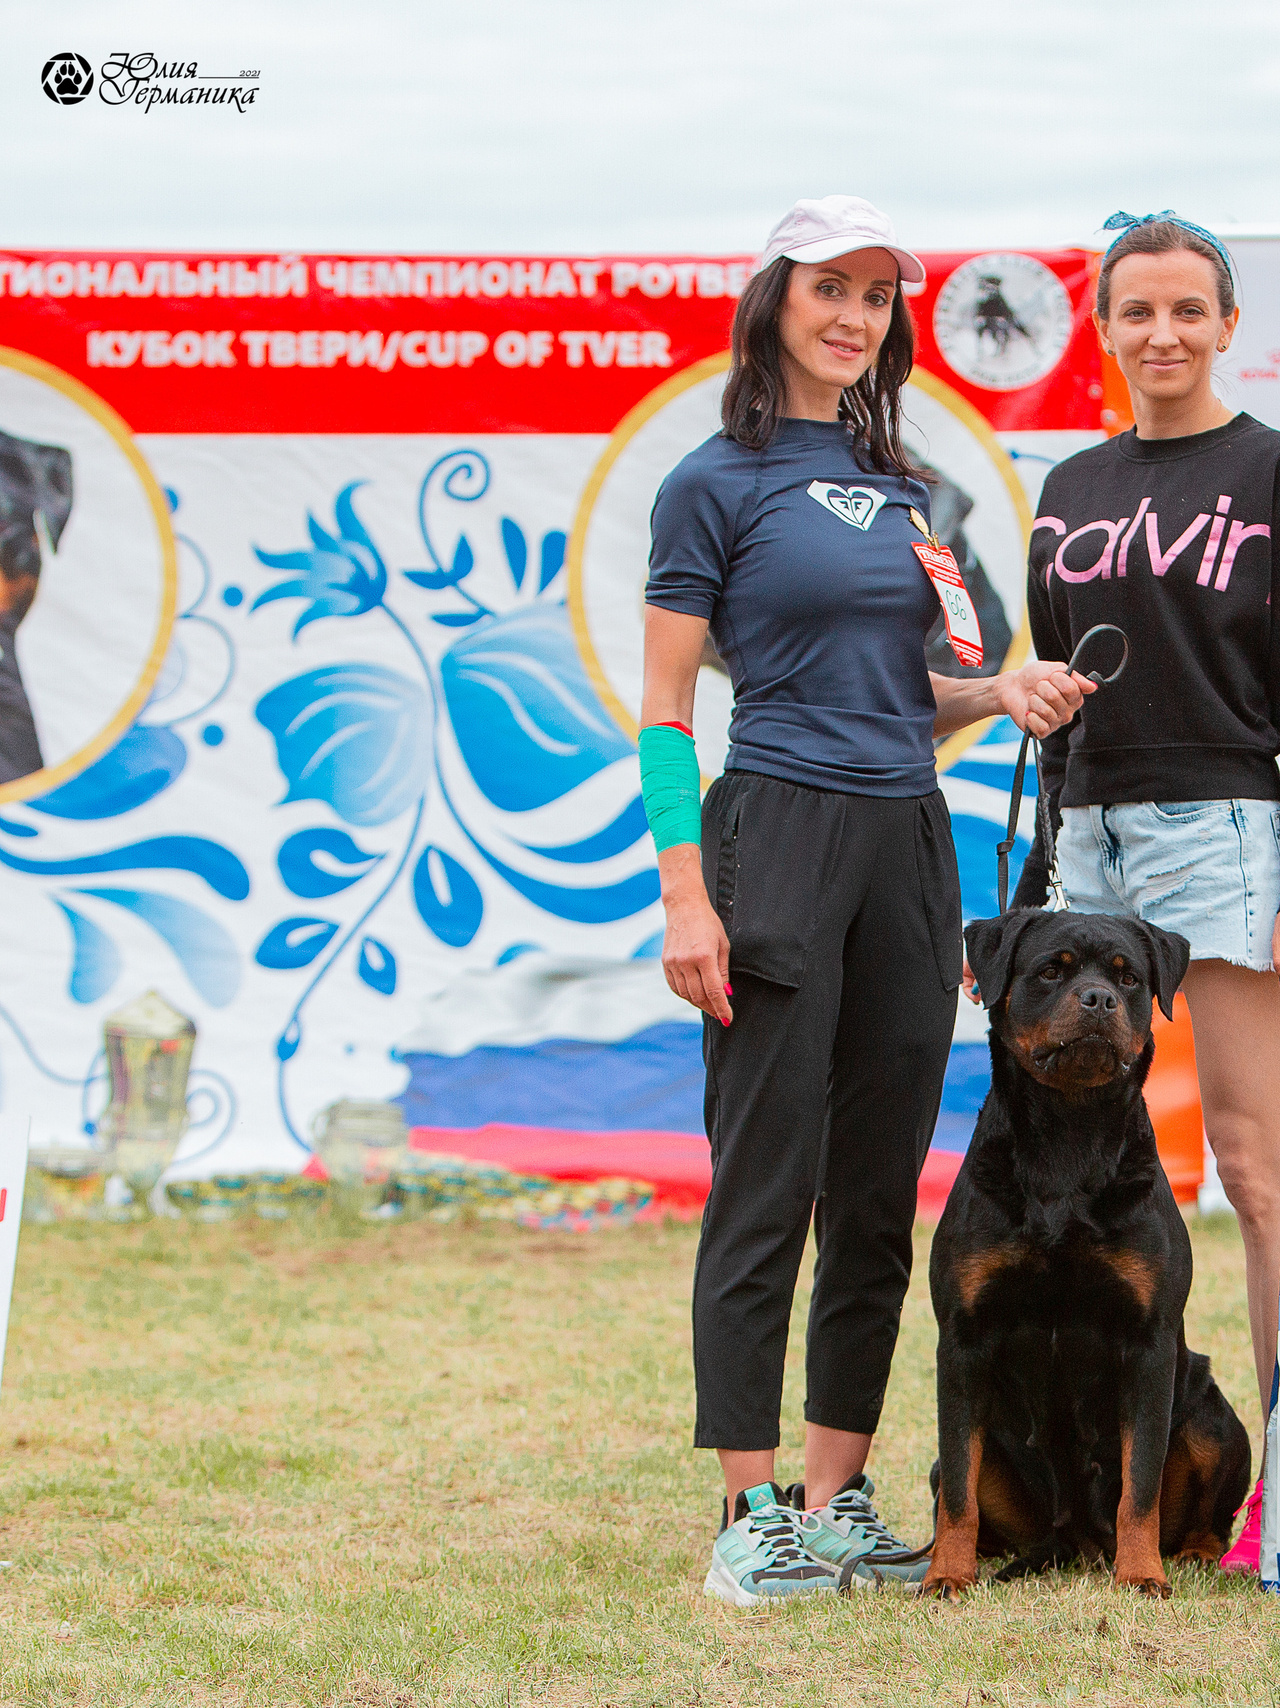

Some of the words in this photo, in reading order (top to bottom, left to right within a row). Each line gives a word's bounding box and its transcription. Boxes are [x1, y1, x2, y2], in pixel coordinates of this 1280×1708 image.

[316, 261, 601, 298] ЧЕМПИОНАТ
[611, 262, 752, 299] РОТВЕ
[86, 330, 238, 368] КУБОК
[240, 330, 489, 373] ТВЕРИ/CUP
[493, 330, 554, 368] OF
[558, 330, 673, 368] TVER
